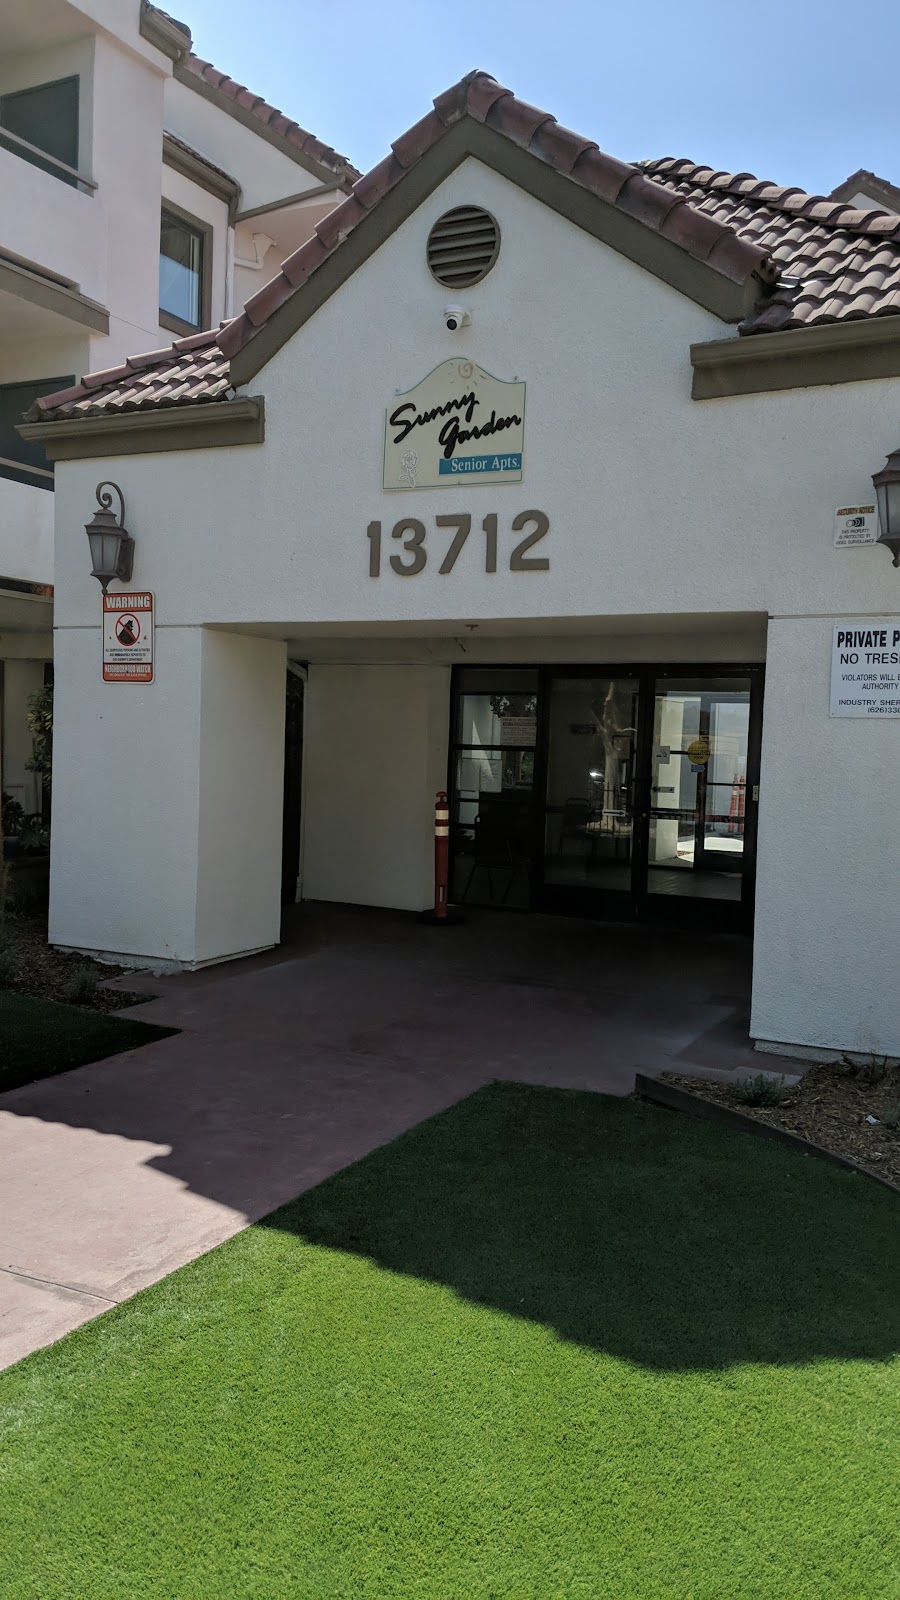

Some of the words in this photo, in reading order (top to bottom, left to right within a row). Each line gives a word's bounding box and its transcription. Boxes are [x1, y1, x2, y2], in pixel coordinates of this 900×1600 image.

[390, 391, 479, 444] Sunny
[439, 410, 522, 459] Garden
[451, 457, 488, 472] Senior
[491, 456, 520, 472] Apts.
[367, 509, 550, 577] 13712
[106, 596, 150, 608] WARNING
[838, 631, 887, 648] PRIVATE
[840, 653, 859, 664] NO
[865, 652, 900, 664] TRES
[880, 673, 895, 681] WILL
